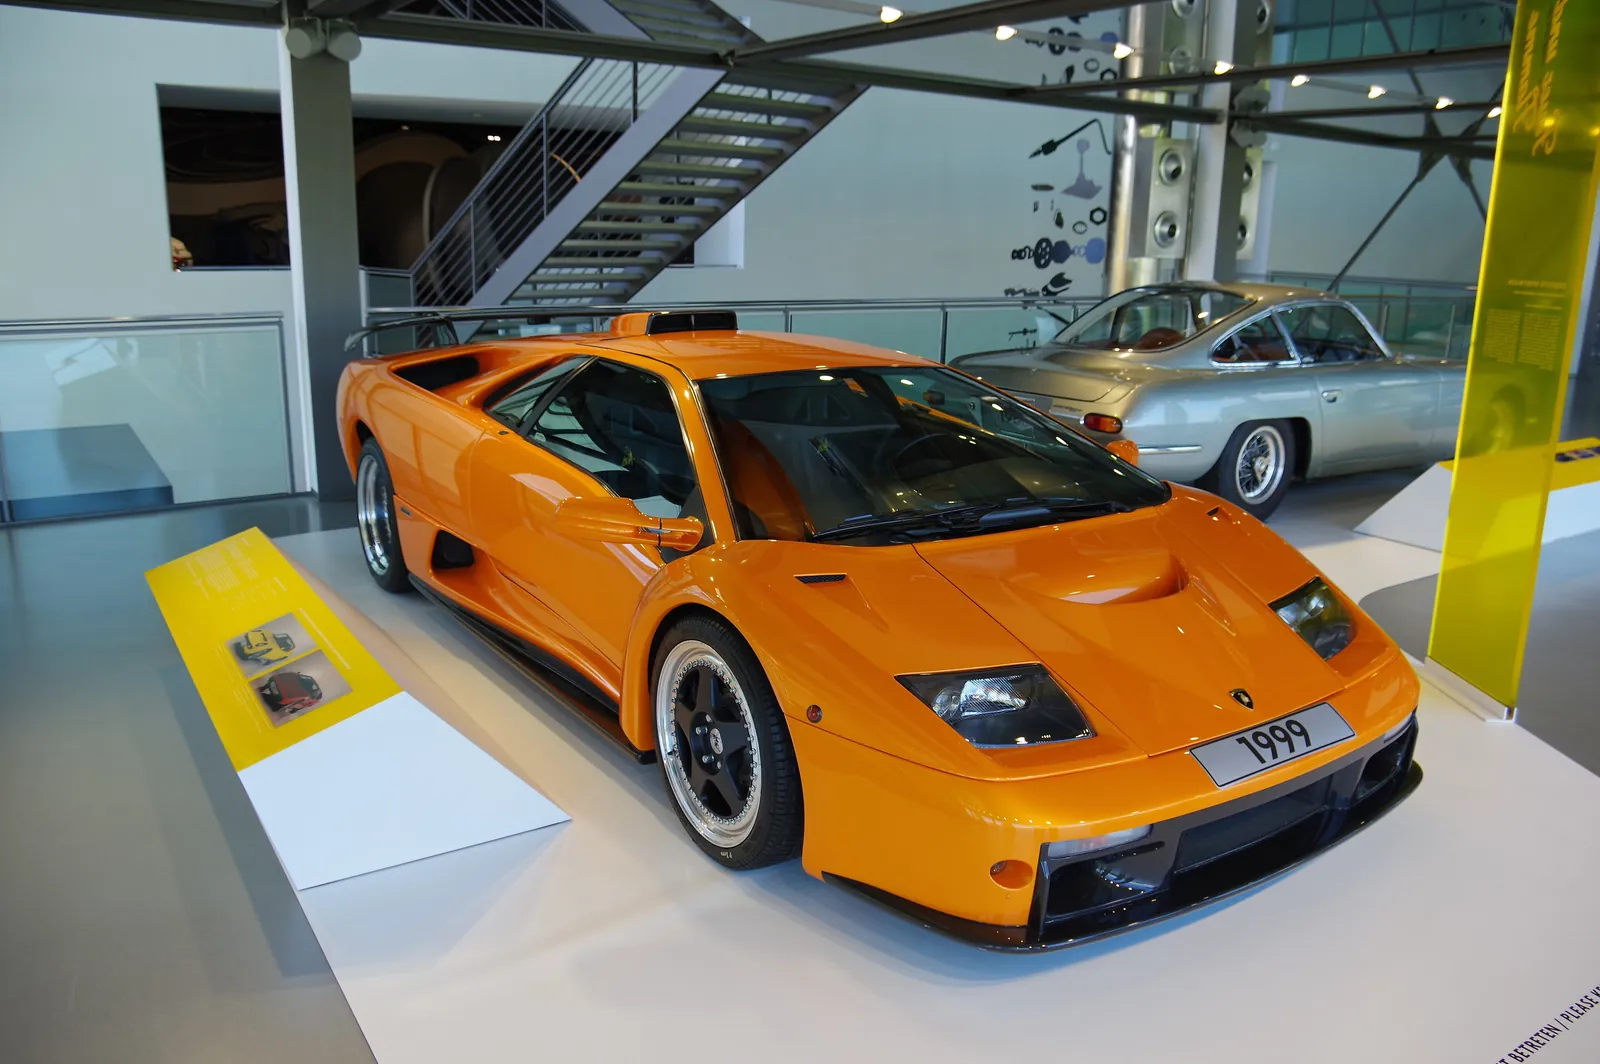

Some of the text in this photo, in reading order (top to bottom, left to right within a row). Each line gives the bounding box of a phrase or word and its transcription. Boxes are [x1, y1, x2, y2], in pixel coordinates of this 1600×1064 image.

[1236, 719, 1312, 765] 1999
[1554, 1017, 1570, 1031] /
[1560, 995, 1600, 1024] PLEASE
[1507, 1023, 1563, 1063] BETRETEN
